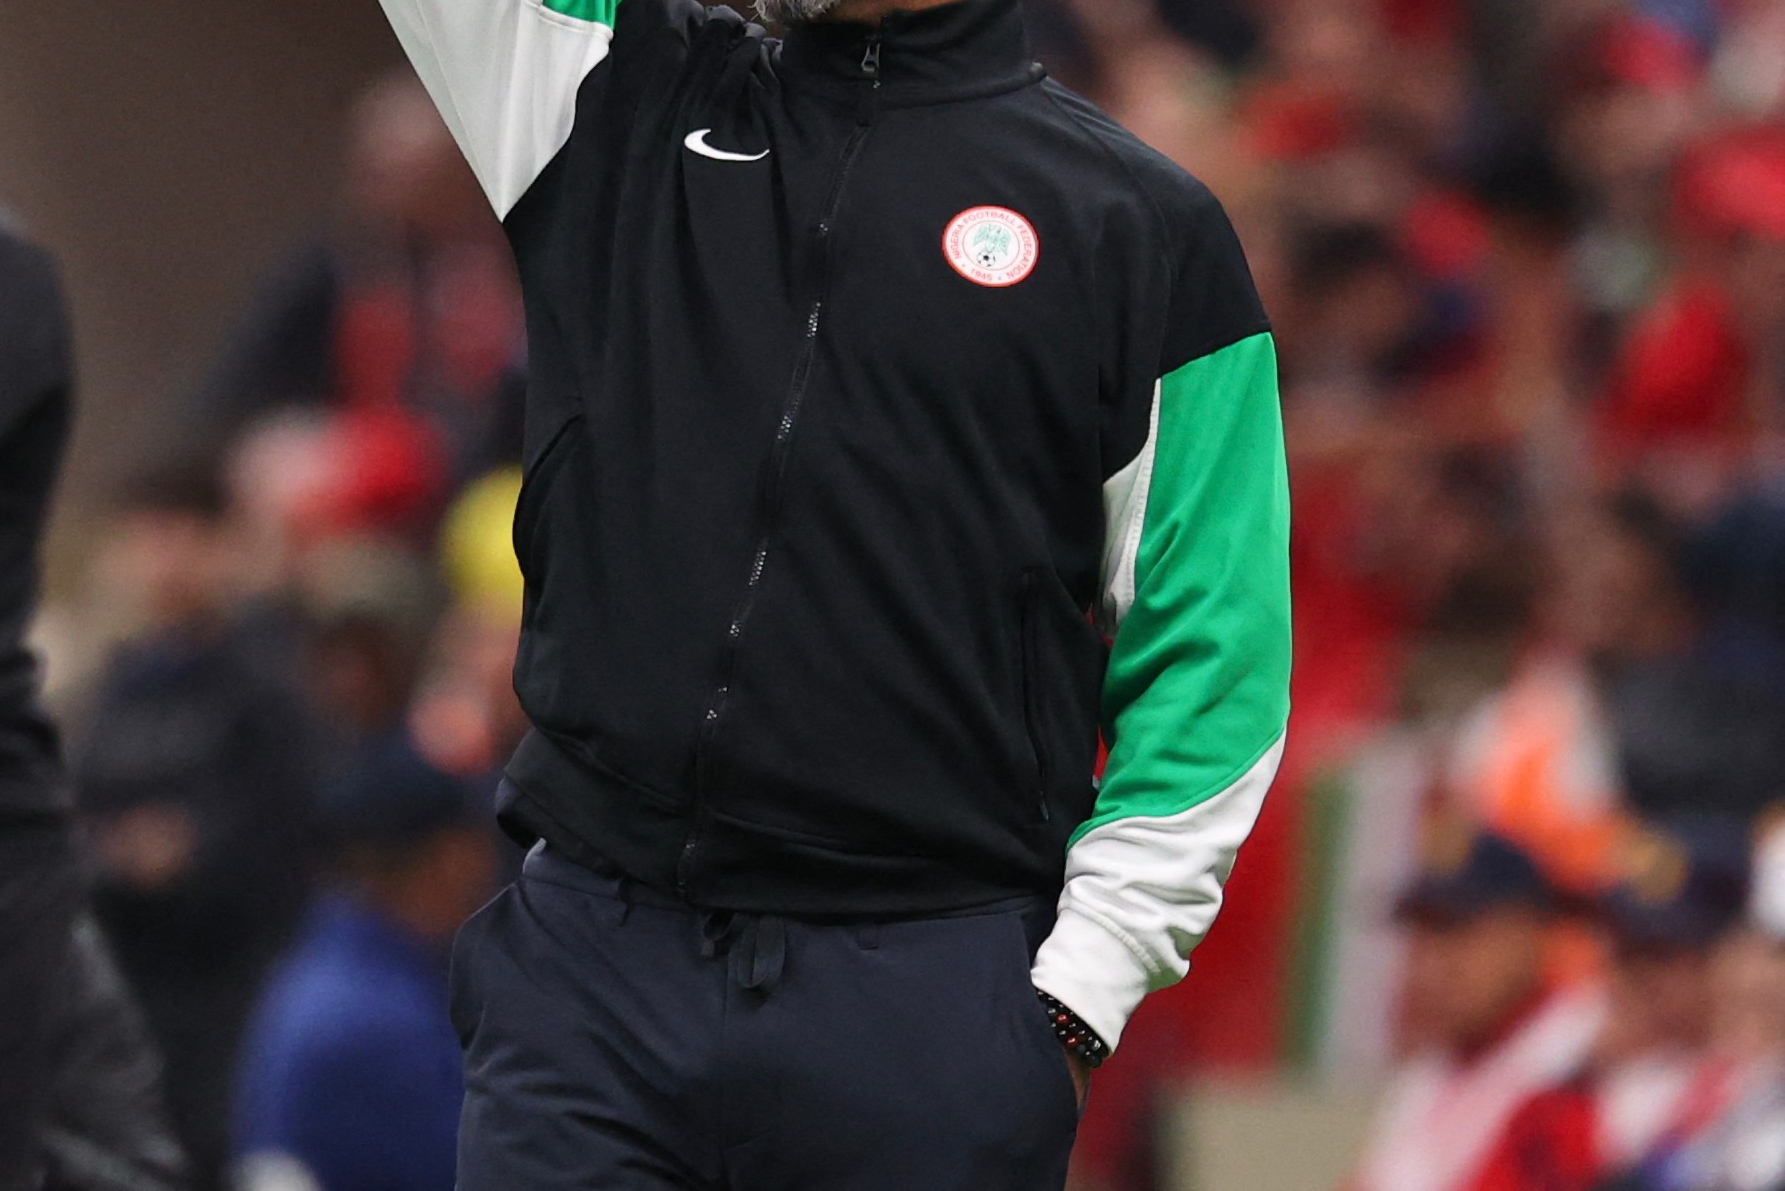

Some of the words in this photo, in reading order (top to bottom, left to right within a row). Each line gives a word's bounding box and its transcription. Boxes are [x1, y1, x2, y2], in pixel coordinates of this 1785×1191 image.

[963, 211, 1016, 225] FOOTBALL
[1006, 225, 1032, 278] FEDERATION
[971, 268, 993, 281] 1945
